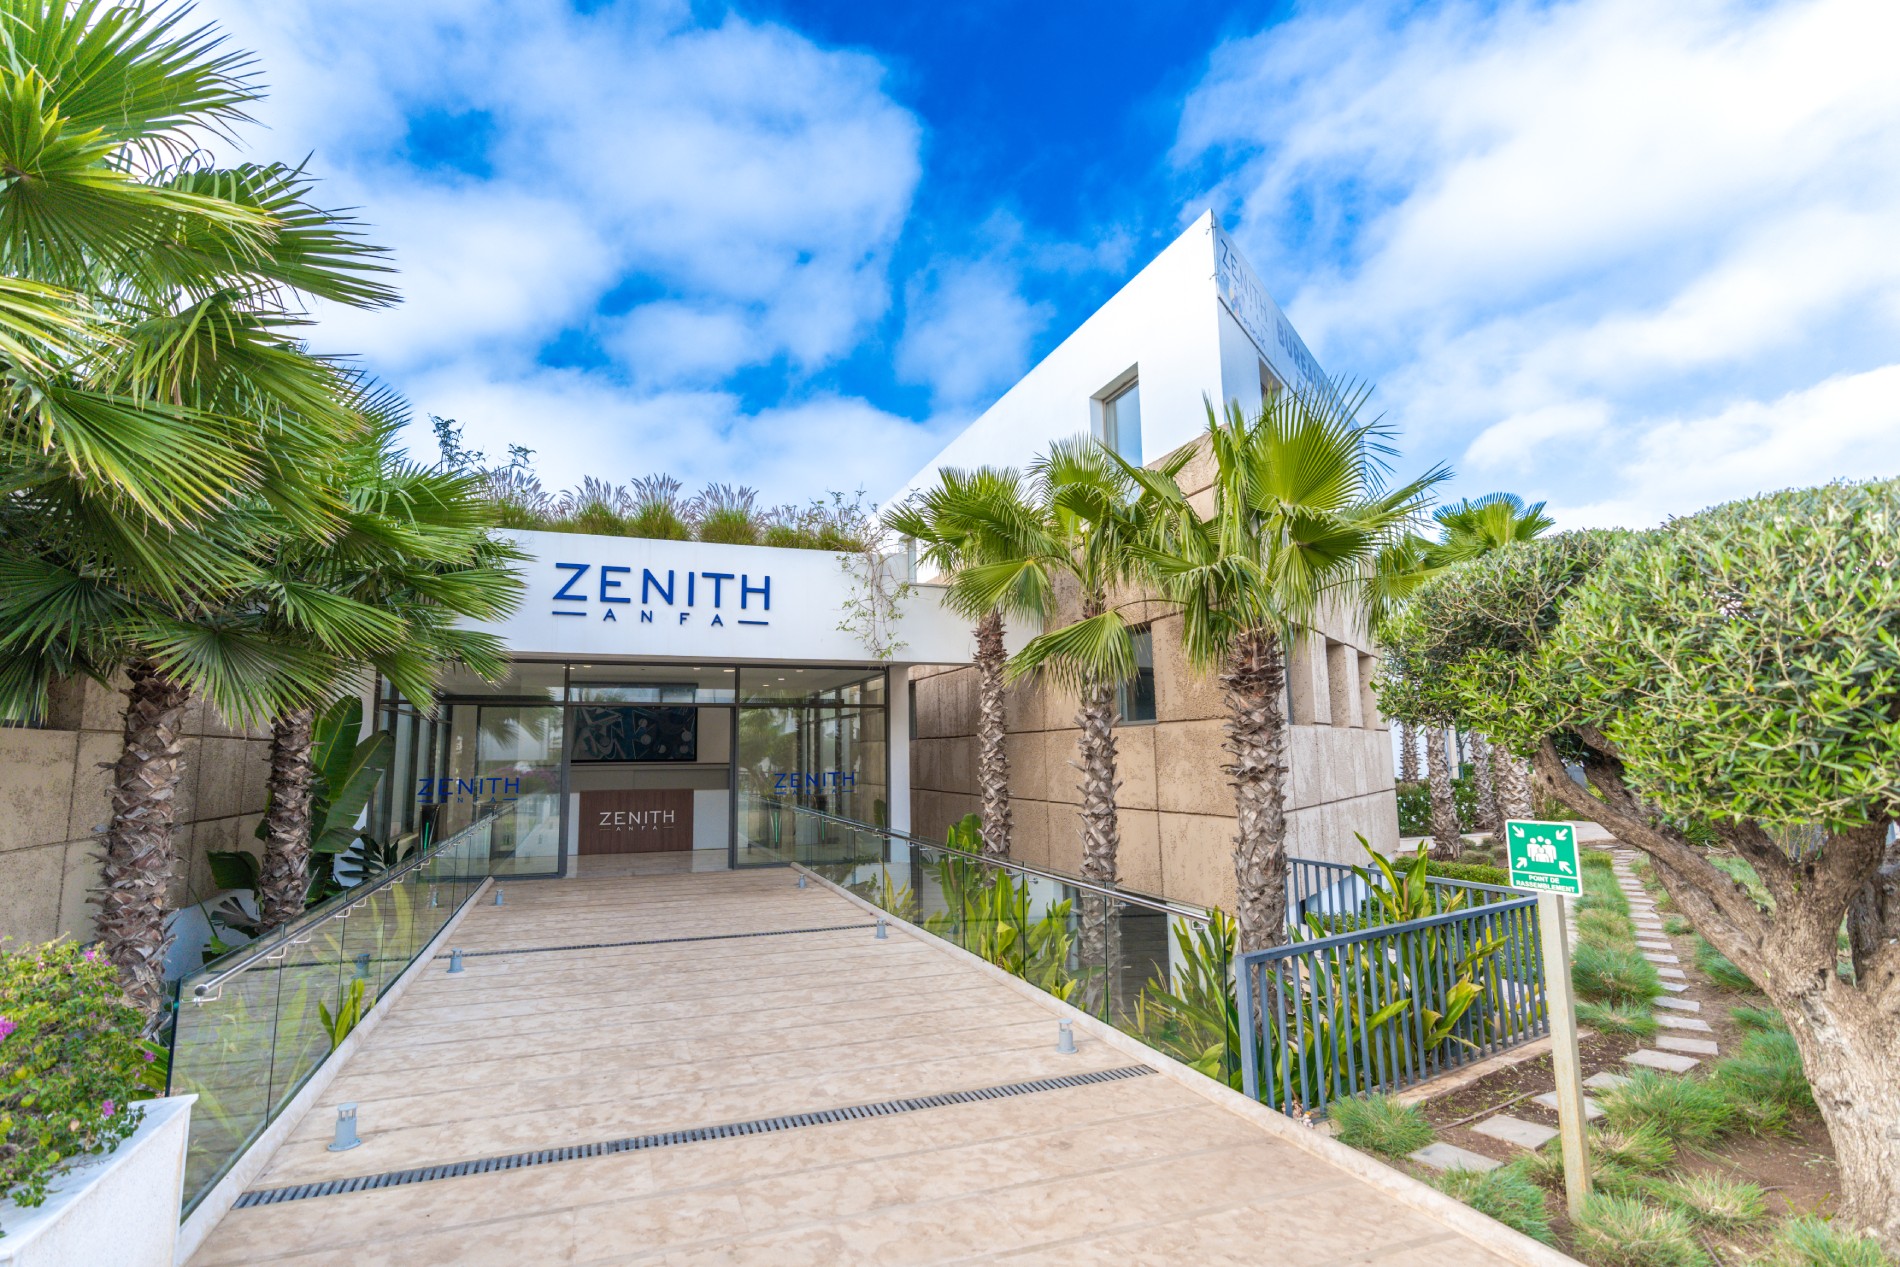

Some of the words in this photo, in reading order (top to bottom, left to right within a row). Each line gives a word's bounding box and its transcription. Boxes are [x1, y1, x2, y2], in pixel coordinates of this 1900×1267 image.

[1220, 238, 1268, 323] ZENITH
[552, 562, 771, 610] ZENITH
[603, 608, 723, 627] ANFA
[417, 777, 519, 795] ZENITH
[774, 771, 855, 788] ZENITH
[599, 810, 675, 825] ZENITH
[1515, 879, 1576, 893] RASSEMBLEMENT
[1528, 874, 1549, 883] POINT
